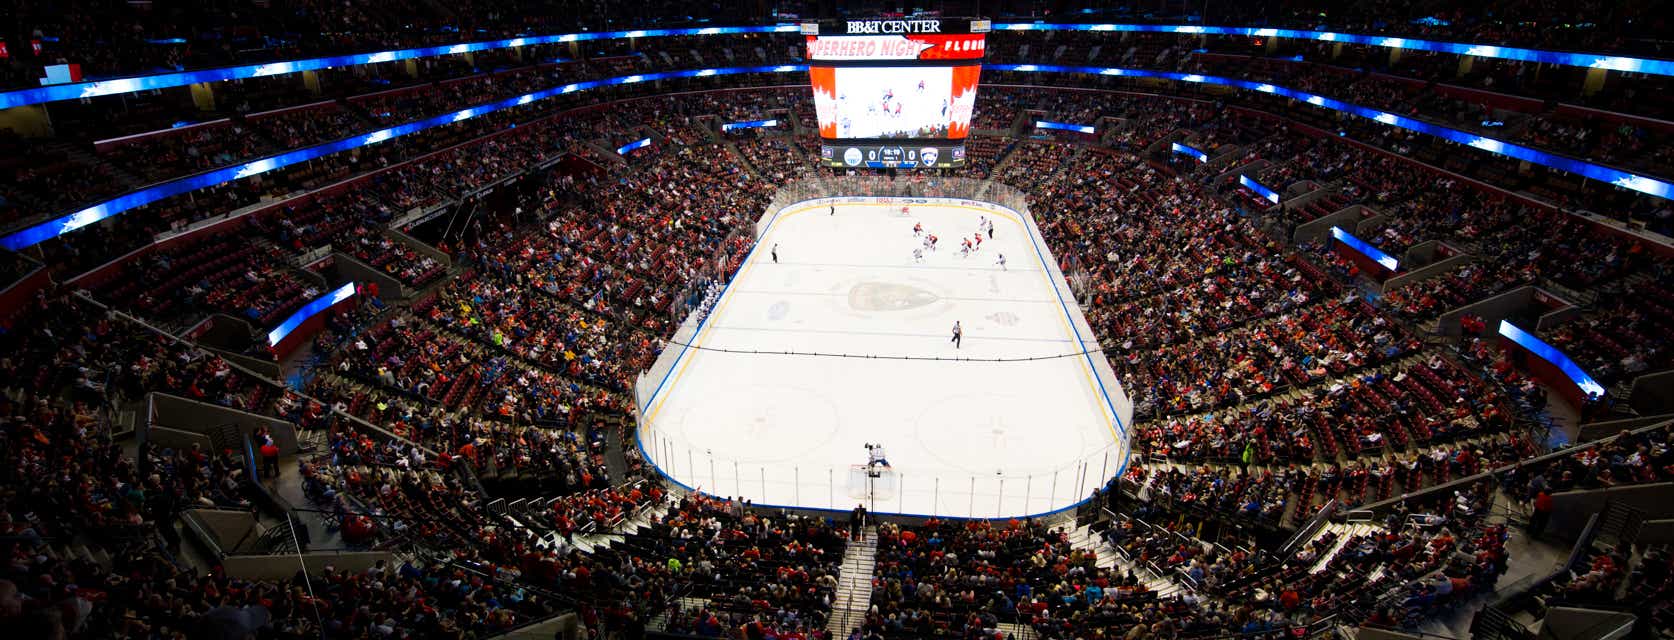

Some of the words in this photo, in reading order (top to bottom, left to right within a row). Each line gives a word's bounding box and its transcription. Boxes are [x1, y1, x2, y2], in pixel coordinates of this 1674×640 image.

[847, 20, 881, 34] BB&T
[881, 20, 941, 34] CENTER
[880, 39, 925, 57] NIGHT
[868, 150, 876, 161] 0
[908, 150, 916, 161] 0
